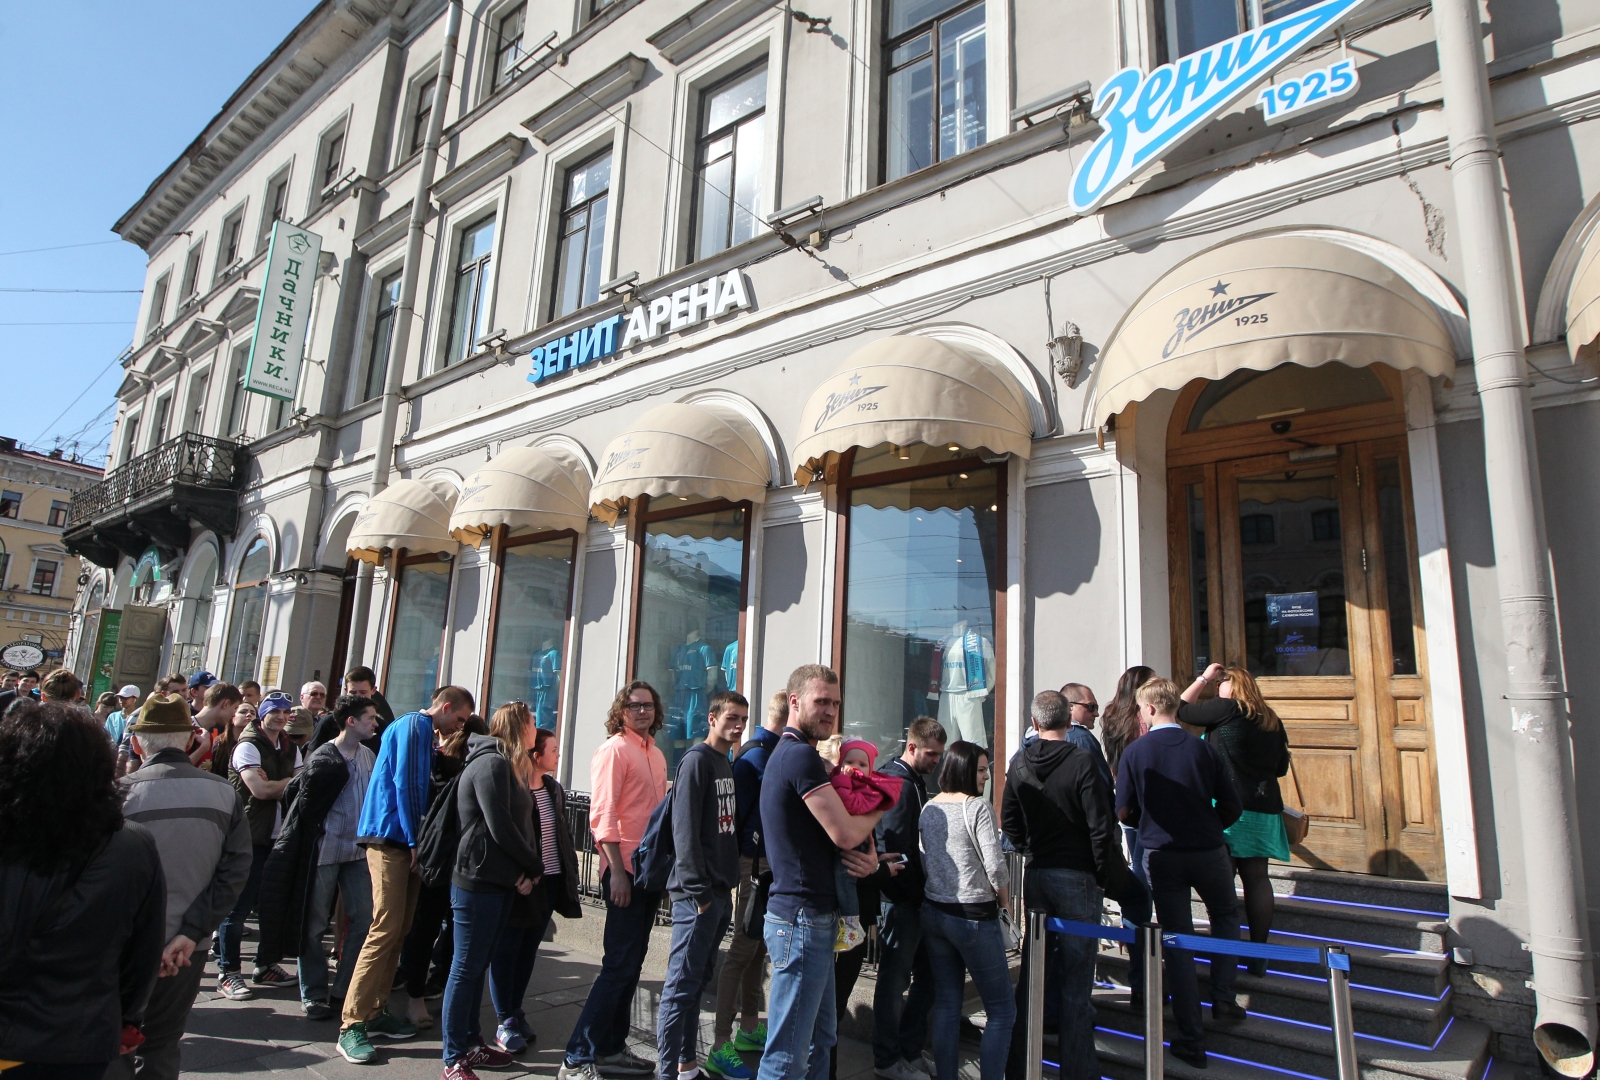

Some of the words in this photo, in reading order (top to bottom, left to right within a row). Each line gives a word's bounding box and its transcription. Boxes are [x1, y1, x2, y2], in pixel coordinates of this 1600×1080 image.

[1261, 62, 1353, 115] 1925
[526, 314, 623, 384] ЗЕНИТ
[622, 268, 752, 350] АРЕНА
[1235, 313, 1269, 327] 1925
[252, 379, 292, 394] WWW.RECA.SU
[857, 402, 879, 412] 1925
